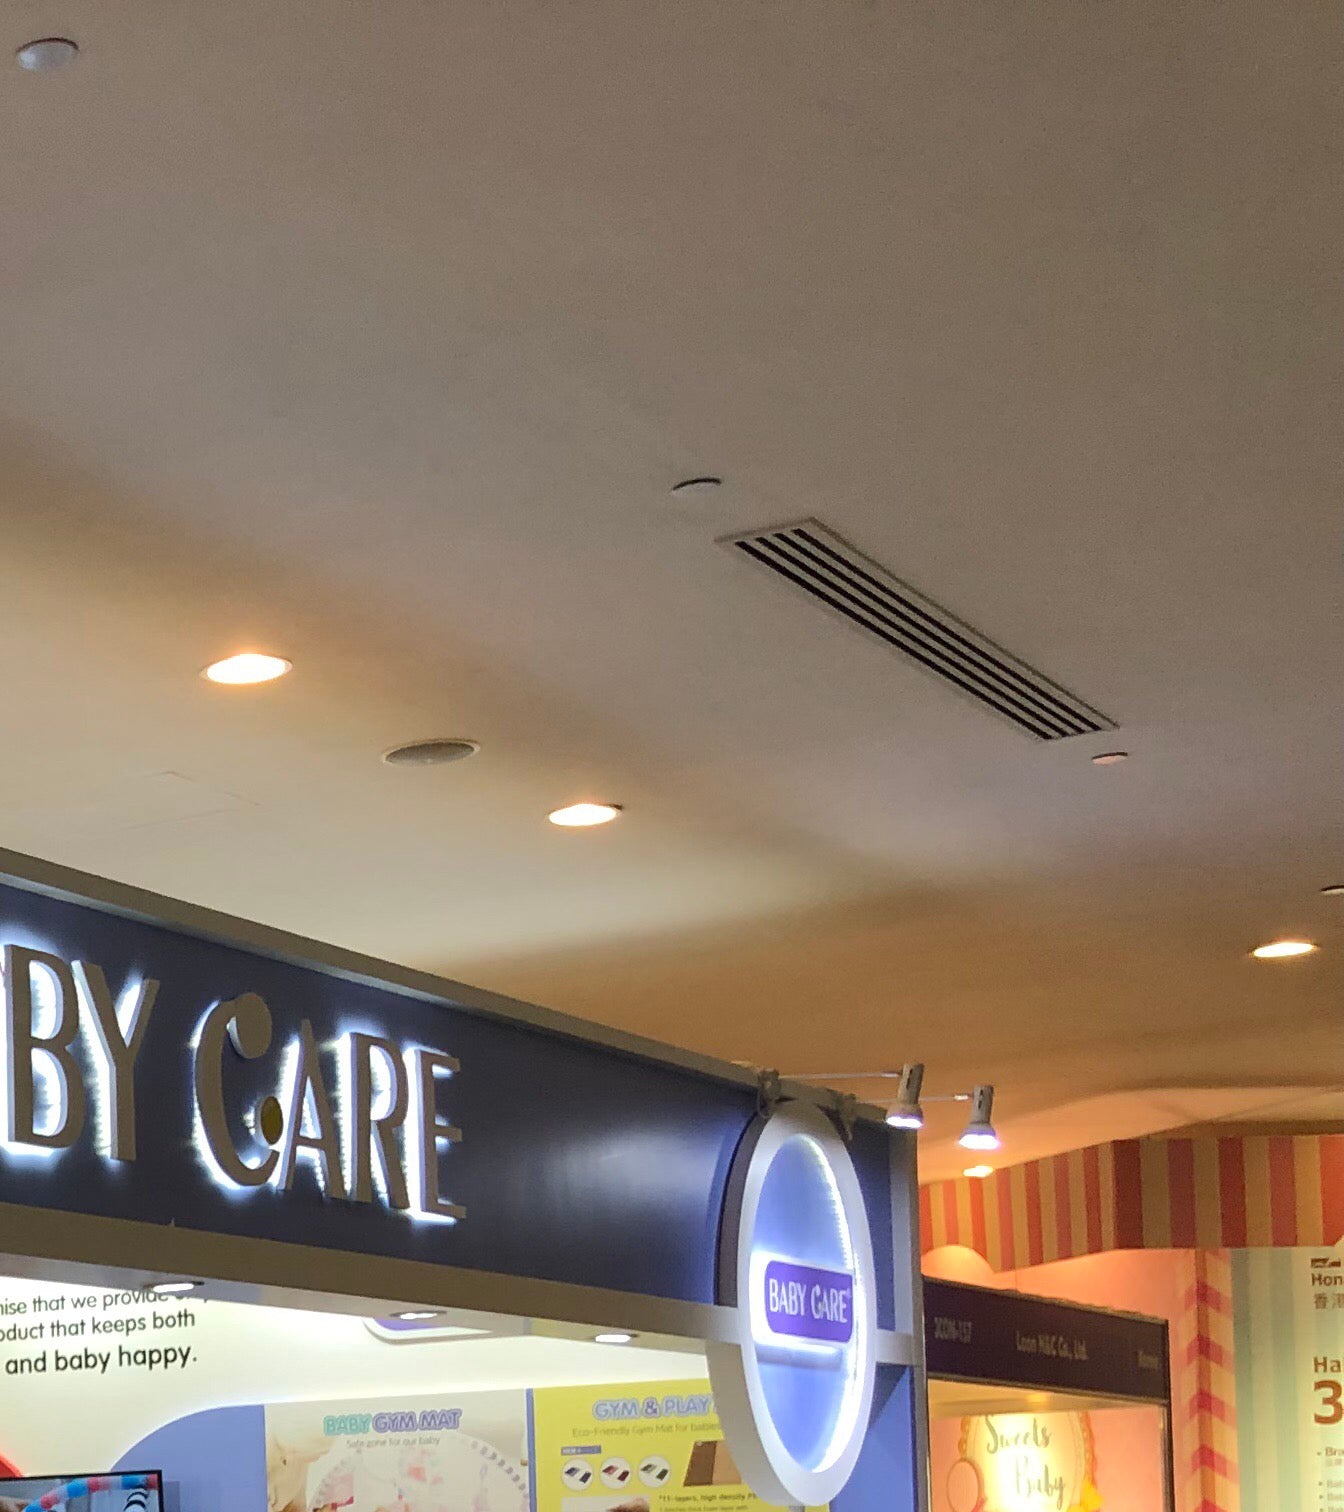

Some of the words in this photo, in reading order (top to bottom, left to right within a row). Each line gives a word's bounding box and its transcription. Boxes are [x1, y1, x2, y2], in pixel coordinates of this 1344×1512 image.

[193, 991, 466, 1219] CARE
[32, 1295, 65, 1313] that
[71, 1296, 97, 1310] we
[769, 1278, 807, 1316] BABY
[810, 1284, 848, 1324] CARE
[50, 1320, 86, 1338] that
[92, 1315, 147, 1336] keeps
[152, 1309, 196, 1330] both
[5, 1351, 47, 1375] and
[55, 1347, 111, 1375] baby
[118, 1345, 198, 1371] happy.
[324, 1414, 372, 1435] BABY
[373, 1411, 416, 1433] GYM
[419, 1408, 462, 1431] MAT
[594, 1398, 640, 1421] GYM
[642, 1397, 659, 1419] &
[662, 1395, 712, 1418] PLAY
[419, 1436, 440, 1447] baby
[573, 1424, 630, 1438] Eco-Friendly
[631, 1424, 653, 1437] Gym
[655, 1423, 673, 1433] Mat
[675, 1422, 688, 1432] for
